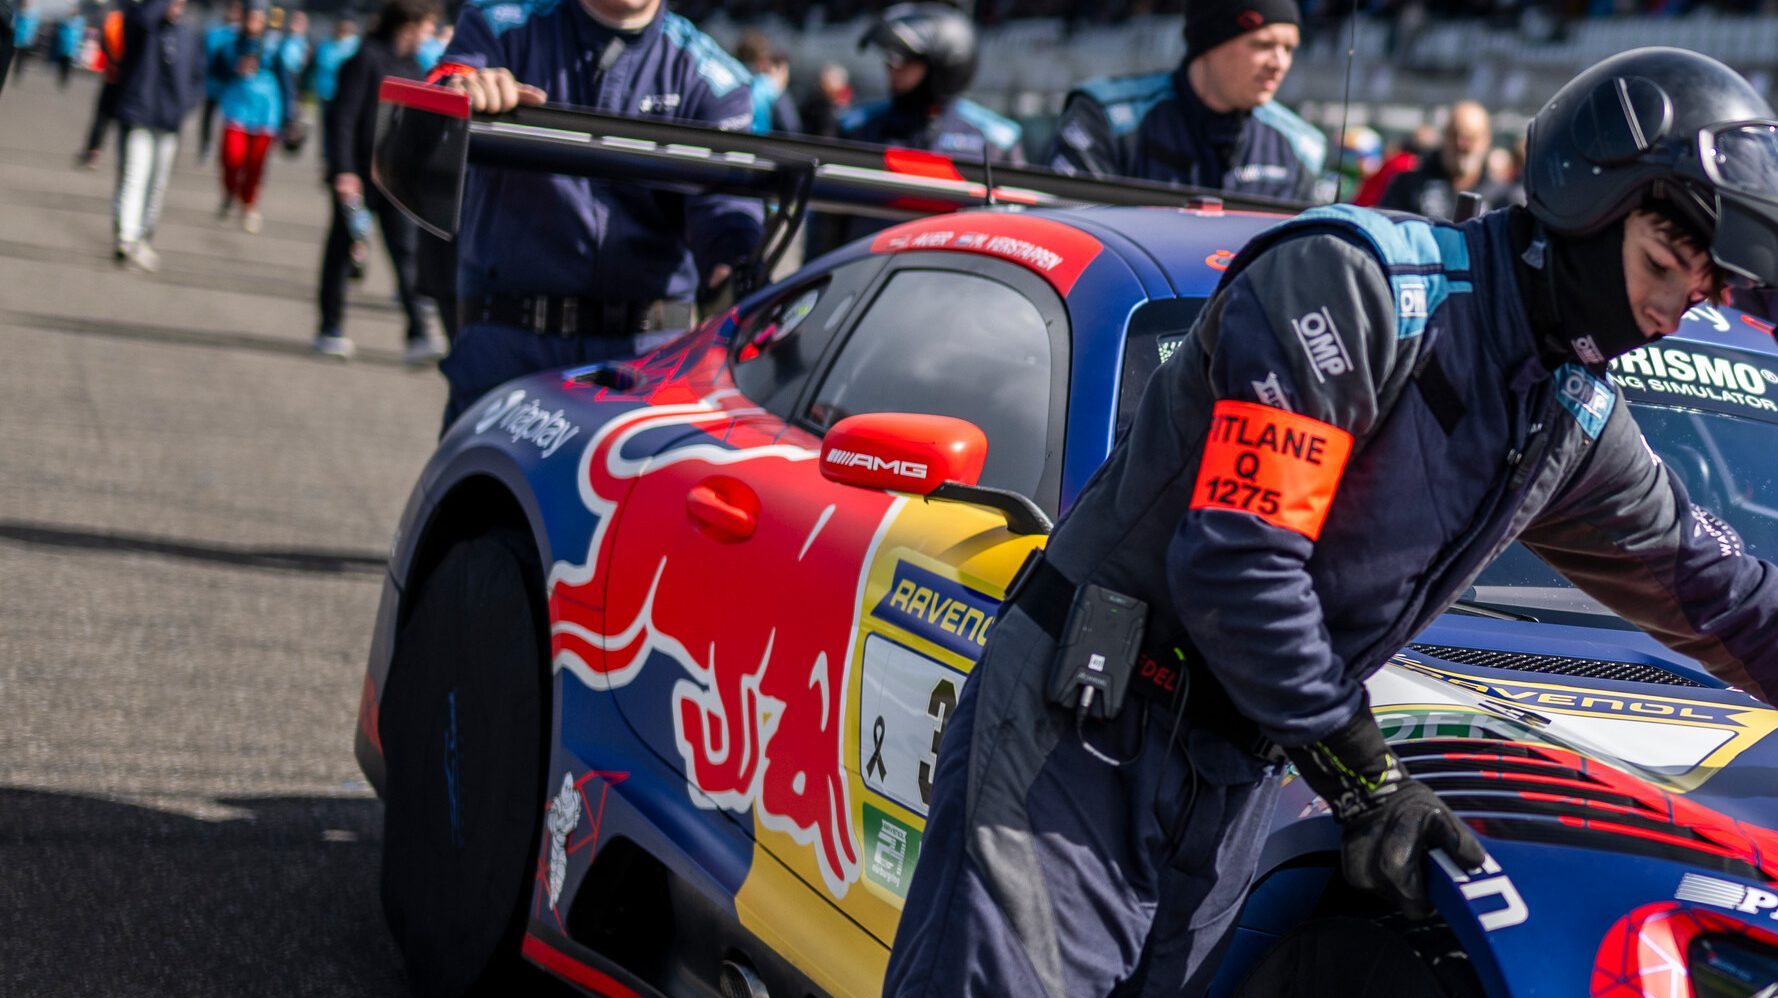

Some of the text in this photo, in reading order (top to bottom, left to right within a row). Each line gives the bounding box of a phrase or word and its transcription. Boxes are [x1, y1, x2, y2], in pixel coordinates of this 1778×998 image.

[1400, 289, 1427, 313] OM
[1301, 312, 1347, 376] OMP
[1607, 375, 1778, 413] NG SIMULATOR
[1212, 415, 1328, 466] ITLANE
[849, 452, 928, 479] AMG
[1236, 452, 1260, 484] Q
[1207, 476, 1281, 515] 1275
[1139, 654, 1178, 693] DEL
